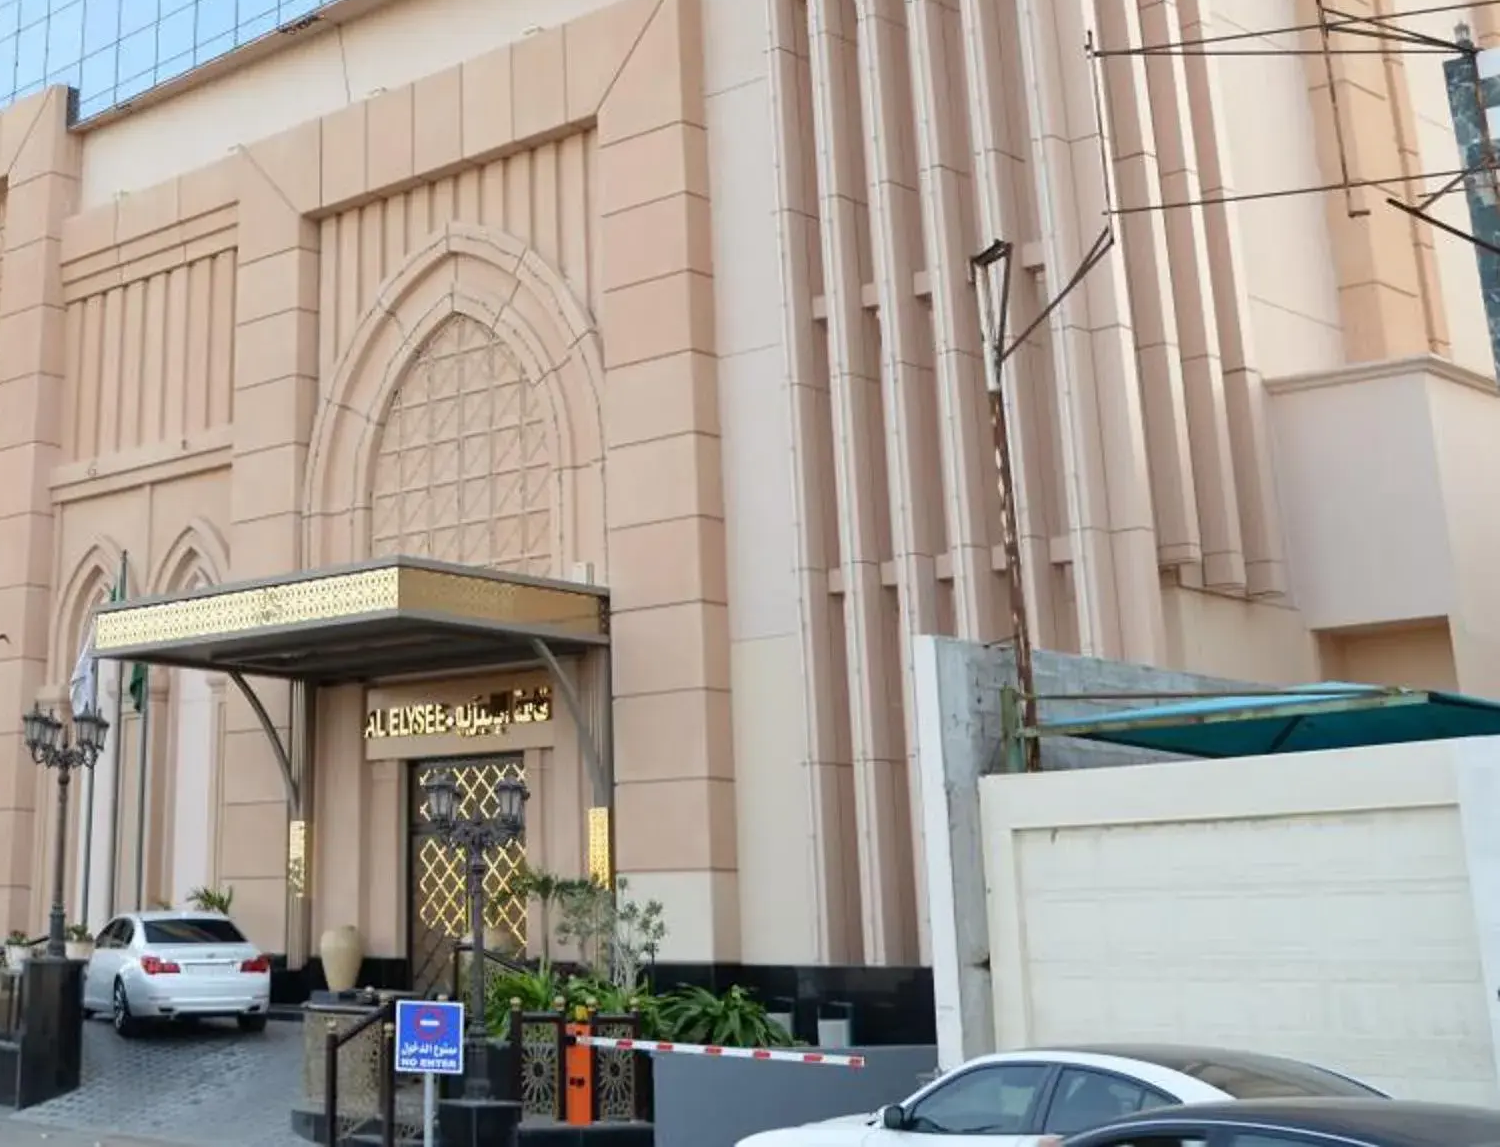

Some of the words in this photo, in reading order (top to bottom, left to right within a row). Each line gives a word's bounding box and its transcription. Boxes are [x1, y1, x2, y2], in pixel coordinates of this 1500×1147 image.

[364, 708, 386, 739] AL
[389, 703, 447, 737] ELYSEE
[401, 1057, 418, 1067] NO
[419, 1058, 457, 1068] ENTER
